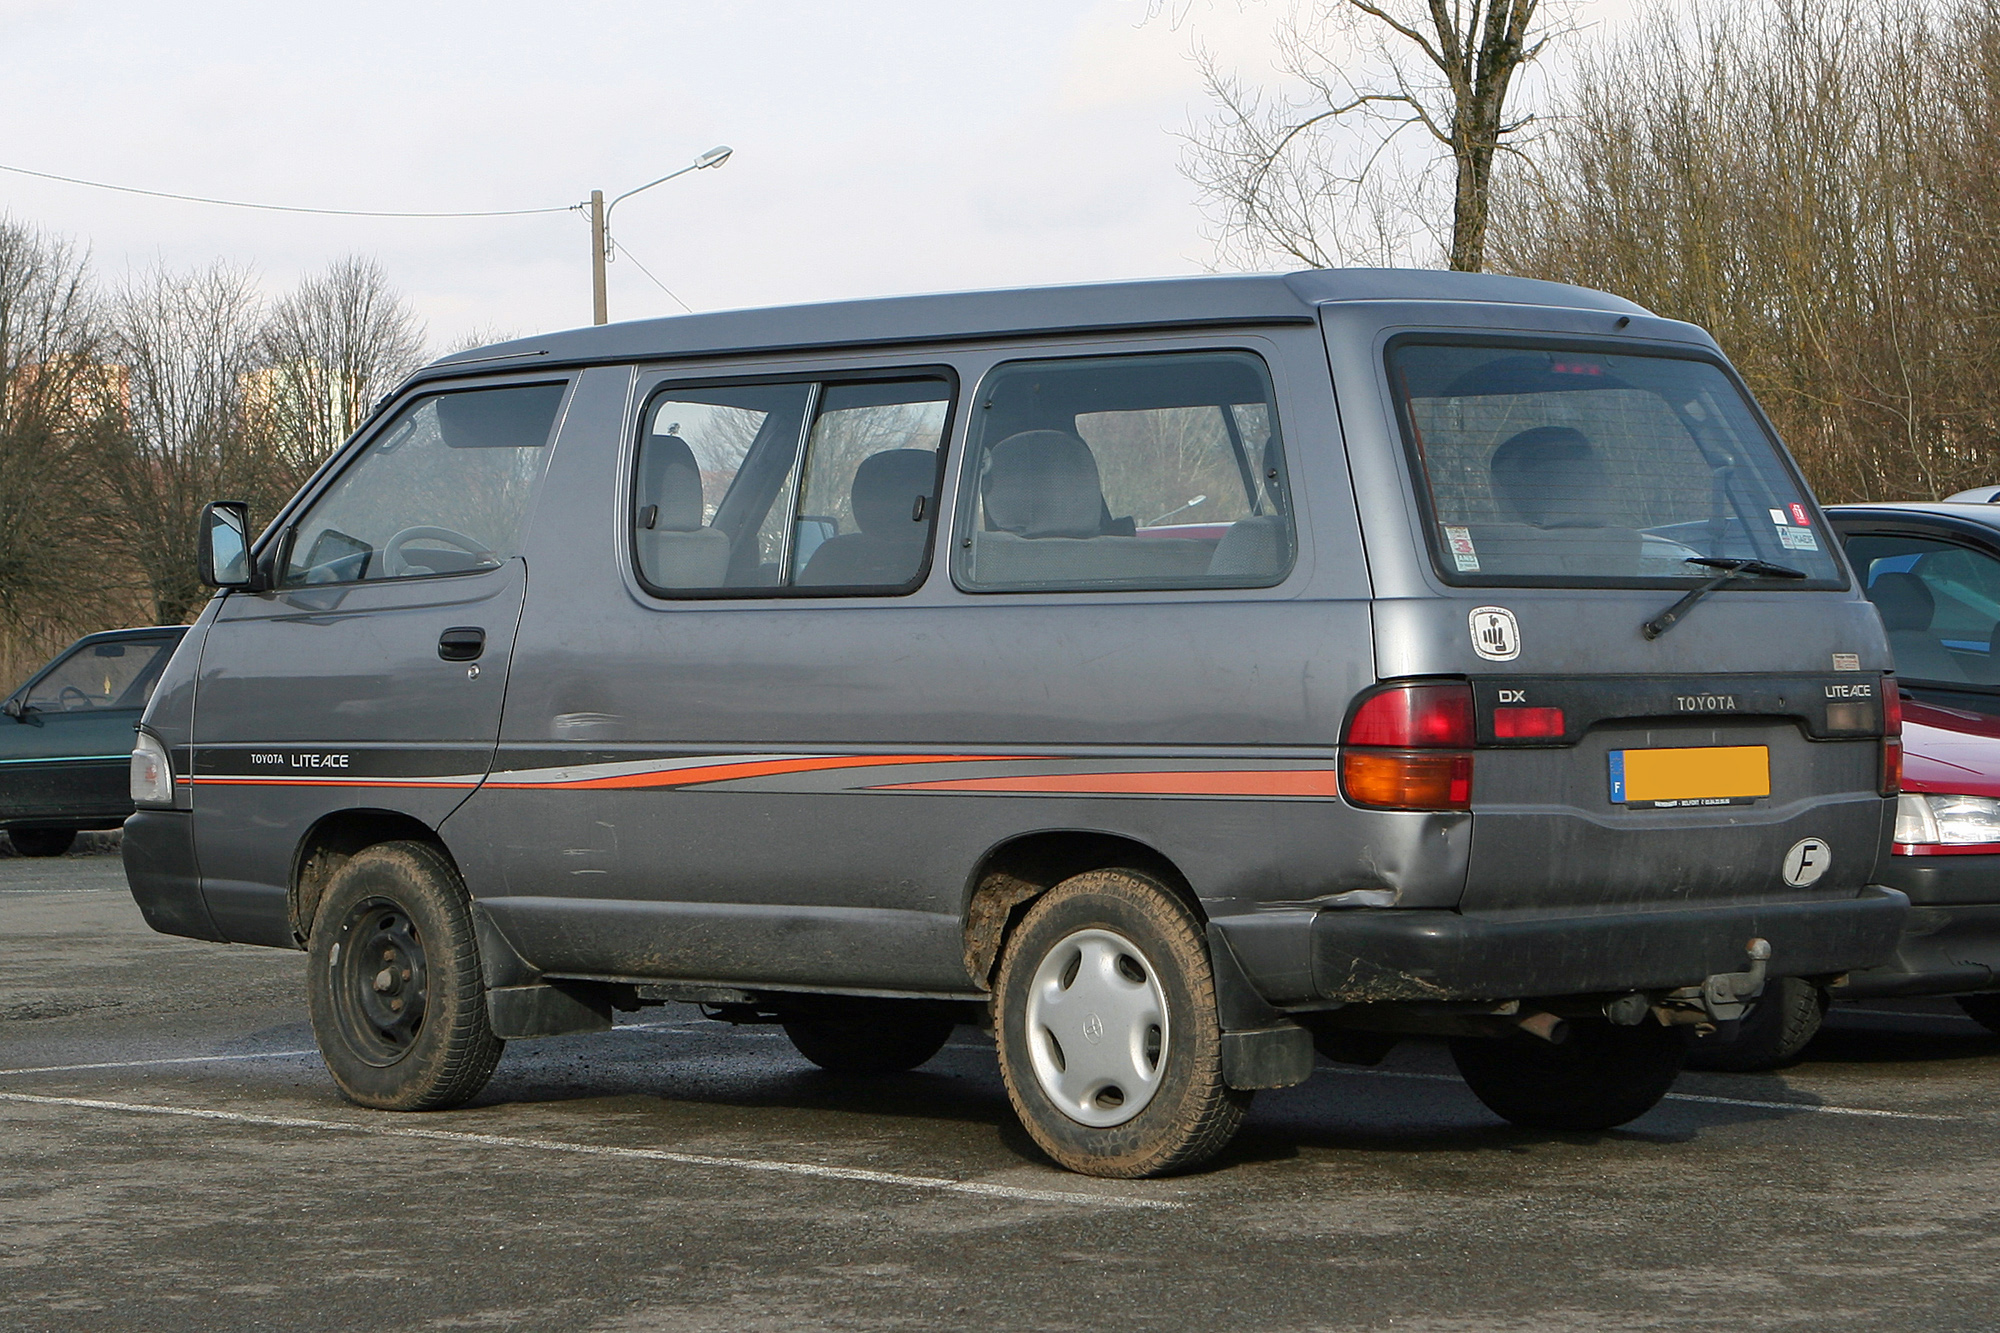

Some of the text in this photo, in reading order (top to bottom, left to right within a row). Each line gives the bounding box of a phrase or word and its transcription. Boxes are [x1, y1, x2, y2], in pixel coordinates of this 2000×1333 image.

[1498, 690, 1526, 703] DX
[1677, 696, 1736, 711] TOYOTA
[251, 754, 284, 764] TOYOTA
[1614, 781, 1621, 794] F
[1794, 845, 1818, 882] F
